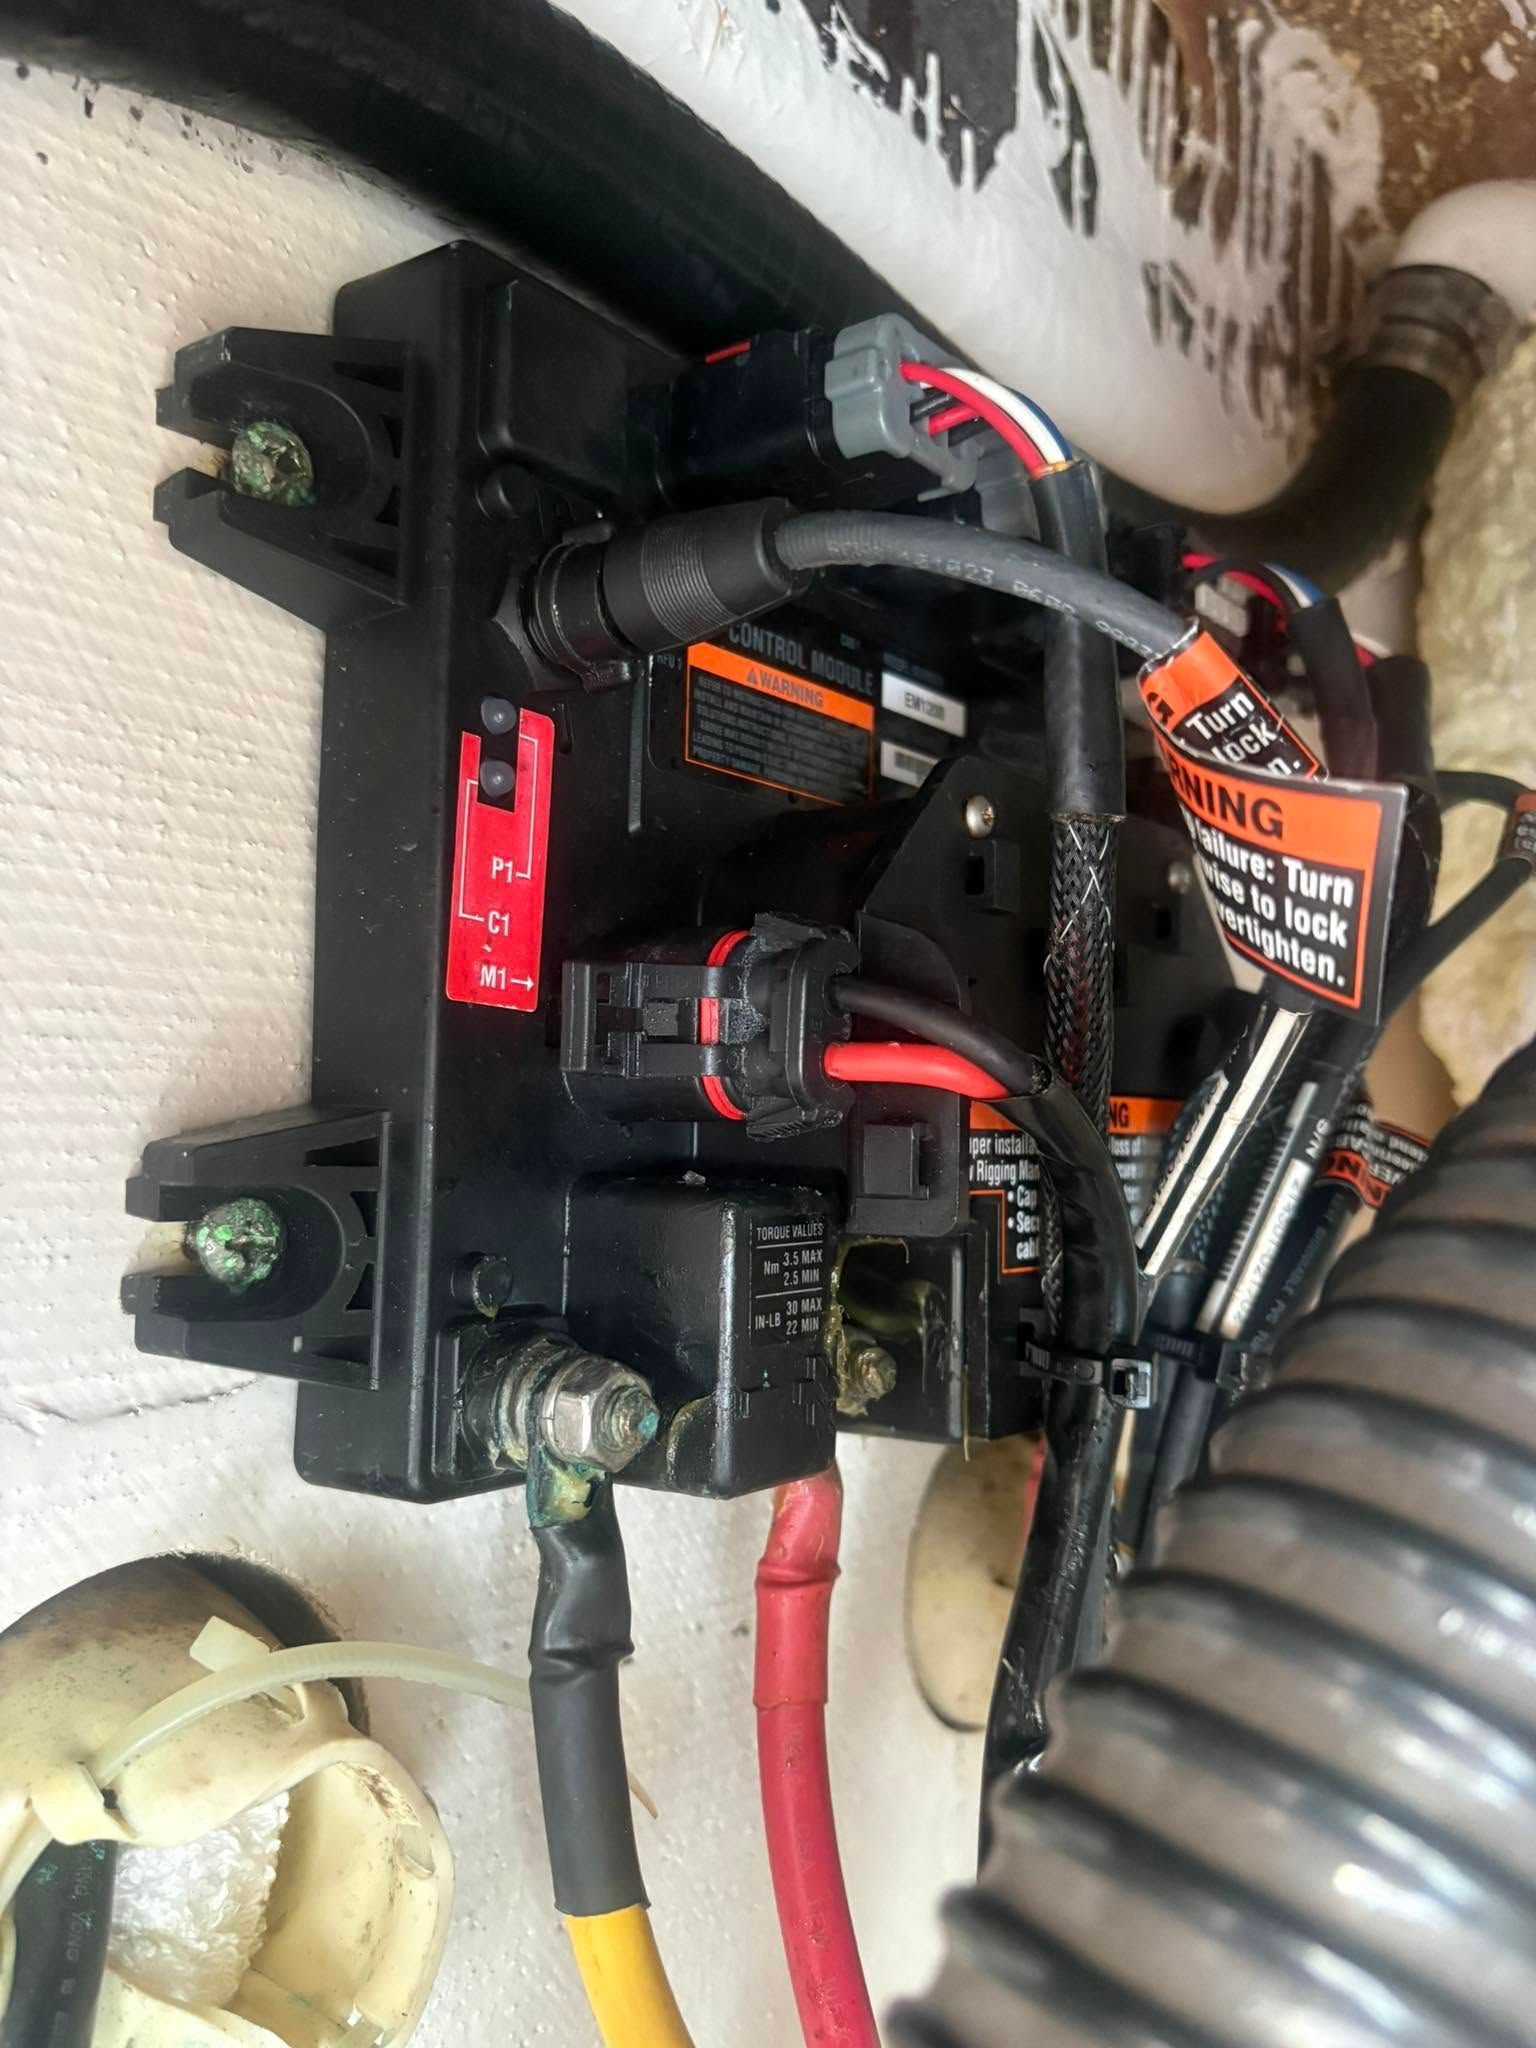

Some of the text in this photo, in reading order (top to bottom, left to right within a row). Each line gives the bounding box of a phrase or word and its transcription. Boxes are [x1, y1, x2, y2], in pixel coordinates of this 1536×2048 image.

[728, 622, 806, 670] CONTROL
[811, 650, 873, 696] MODULE
[759, 669, 824, 708] WARNING
[1185, 691, 1255, 741] Turn
[1211, 721, 1278, 762] lock
[491, 855, 513, 884] P1
[1283, 856, 1354, 907] Turn
[488, 911, 510, 937] C1
[1250, 884, 1276, 921] to
[1284, 902, 1348, 949] lock
[480, 964, 507, 990] M1
[969, 1137, 991, 1159] per
[977, 1160, 1016, 1186] Rigging
[757, 1223, 824, 1241] TORQUE VALUES
[764, 1261, 779, 1276] Nm
[783, 1249, 823, 1266] 3.5 MAX
[784, 1269, 820, 1286] 2.5 MIN
[786, 1297, 823, 1316] 30 MAX
[755, 1312, 781, 1330] IN-LB
[785, 1317, 820, 1336] 22 MIN
